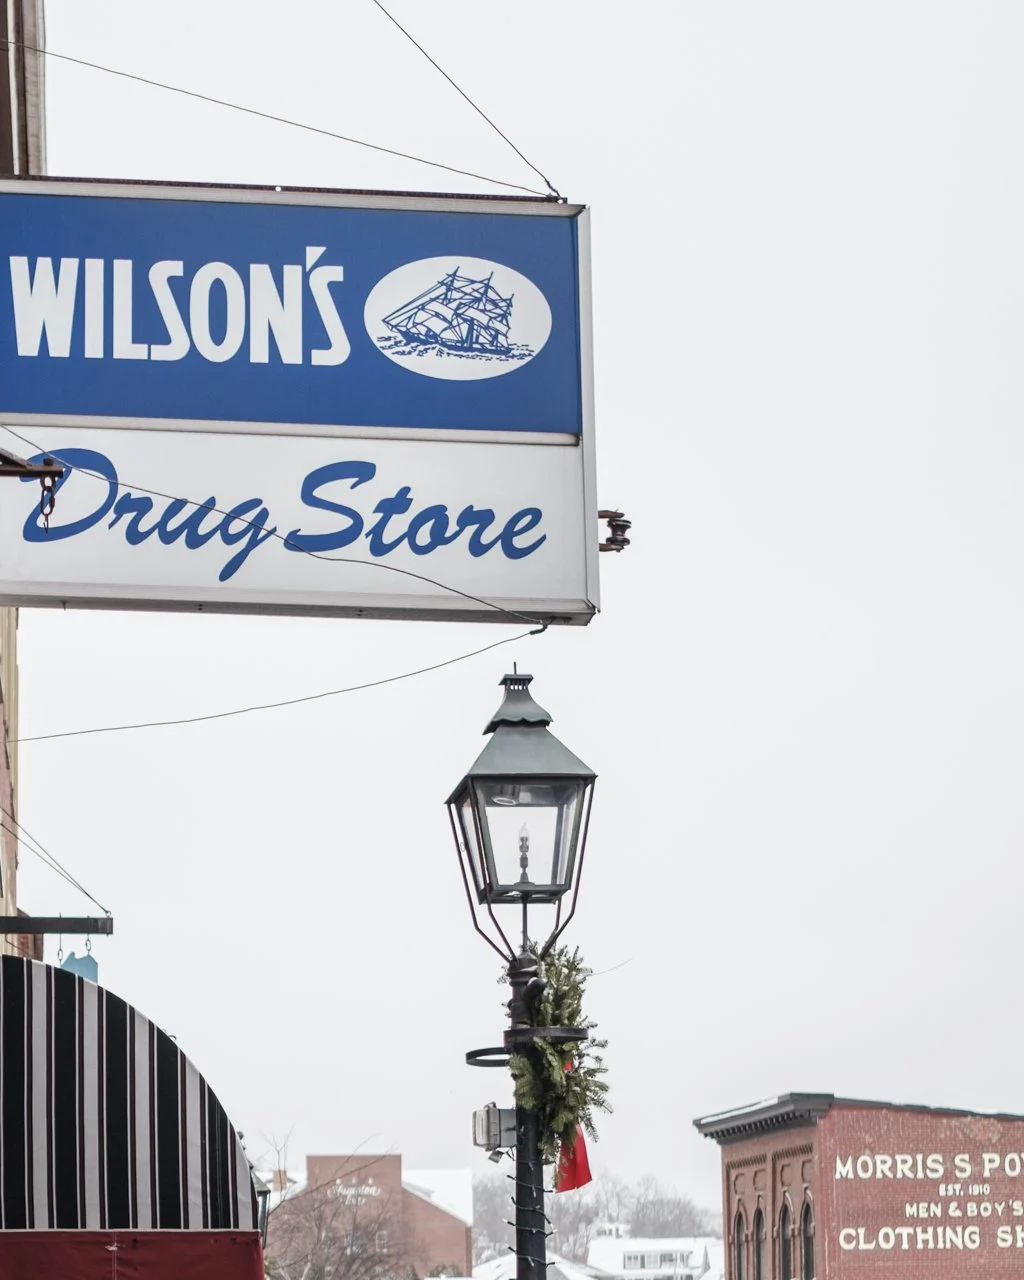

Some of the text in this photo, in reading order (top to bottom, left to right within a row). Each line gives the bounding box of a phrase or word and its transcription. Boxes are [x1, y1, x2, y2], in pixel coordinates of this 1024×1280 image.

[9, 245, 351, 367] WILSON'S
[19, 447, 547, 582] Drug Store
[835, 1152, 1024, 1180] MORRIS S PO
[938, 1183, 964, 1197] EST.
[905, 1199, 1024, 1218] MEN & BOY'S
[838, 1225, 980, 1250] CLOTHING
